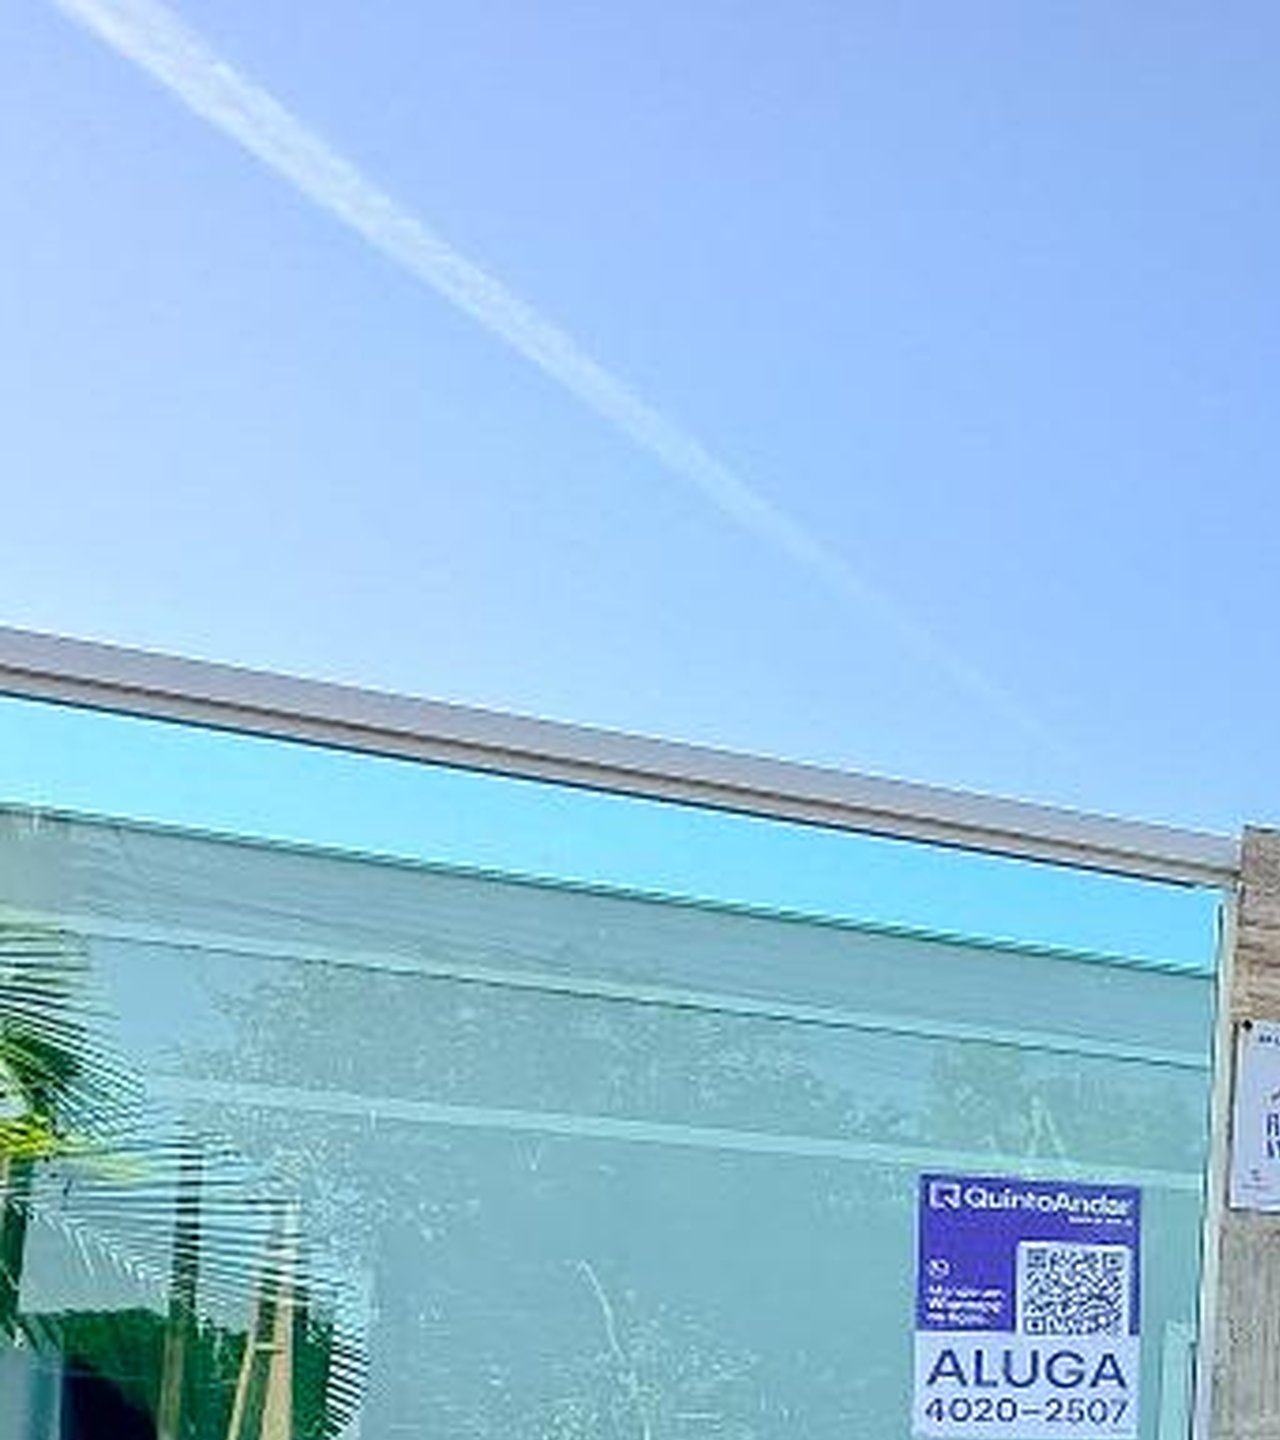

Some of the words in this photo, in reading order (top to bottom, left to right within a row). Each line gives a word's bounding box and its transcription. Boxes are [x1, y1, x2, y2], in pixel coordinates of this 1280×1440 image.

[964, 1184, 1134, 1215] QuintoAndar
[926, 1349, 1128, 1389] ALUGA
[925, 1397, 1129, 1424] 4020-2507
